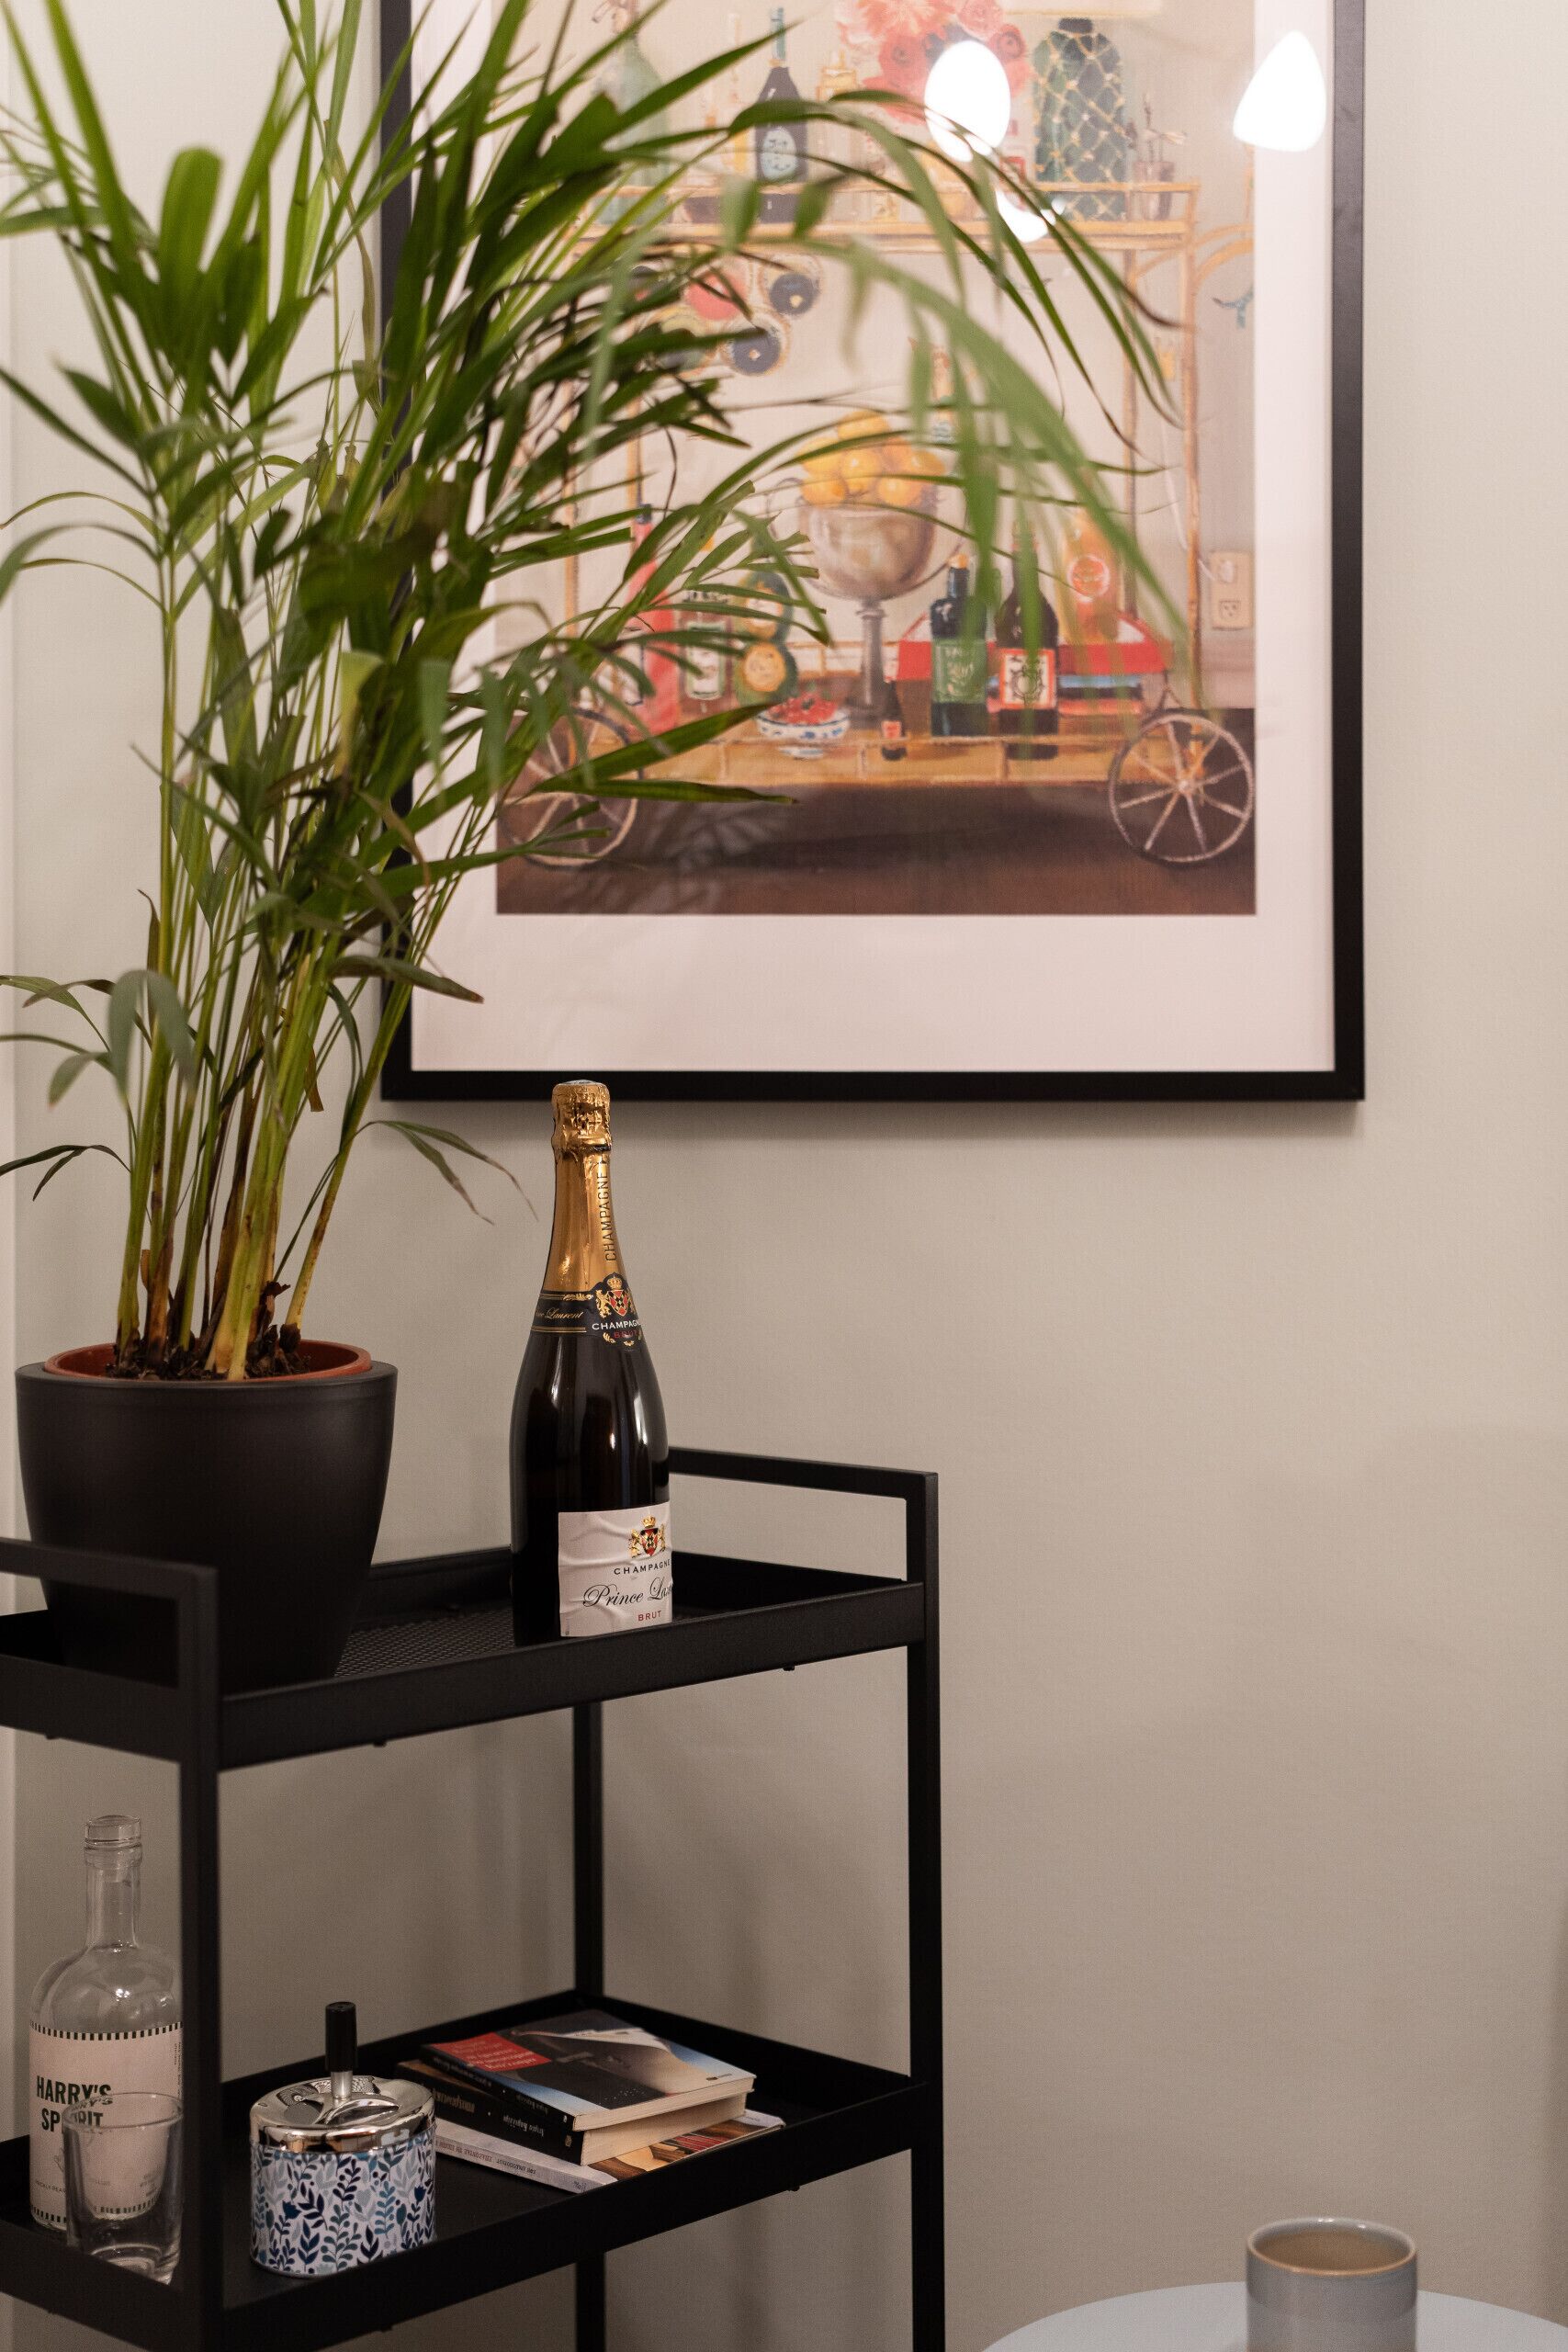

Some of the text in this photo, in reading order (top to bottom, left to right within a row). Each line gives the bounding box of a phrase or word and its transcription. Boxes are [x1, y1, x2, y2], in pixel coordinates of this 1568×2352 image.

[596, 1172, 617, 1261] CHAMPAGNE
[545, 1306, 584, 1319] Laurent
[614, 1558, 671, 1576] CHAMPAGNE
[582, 1584, 644, 1608] Prince
[637, 1610, 662, 1623] BRUT
[36, 2075, 112, 2106] HARRY'S
